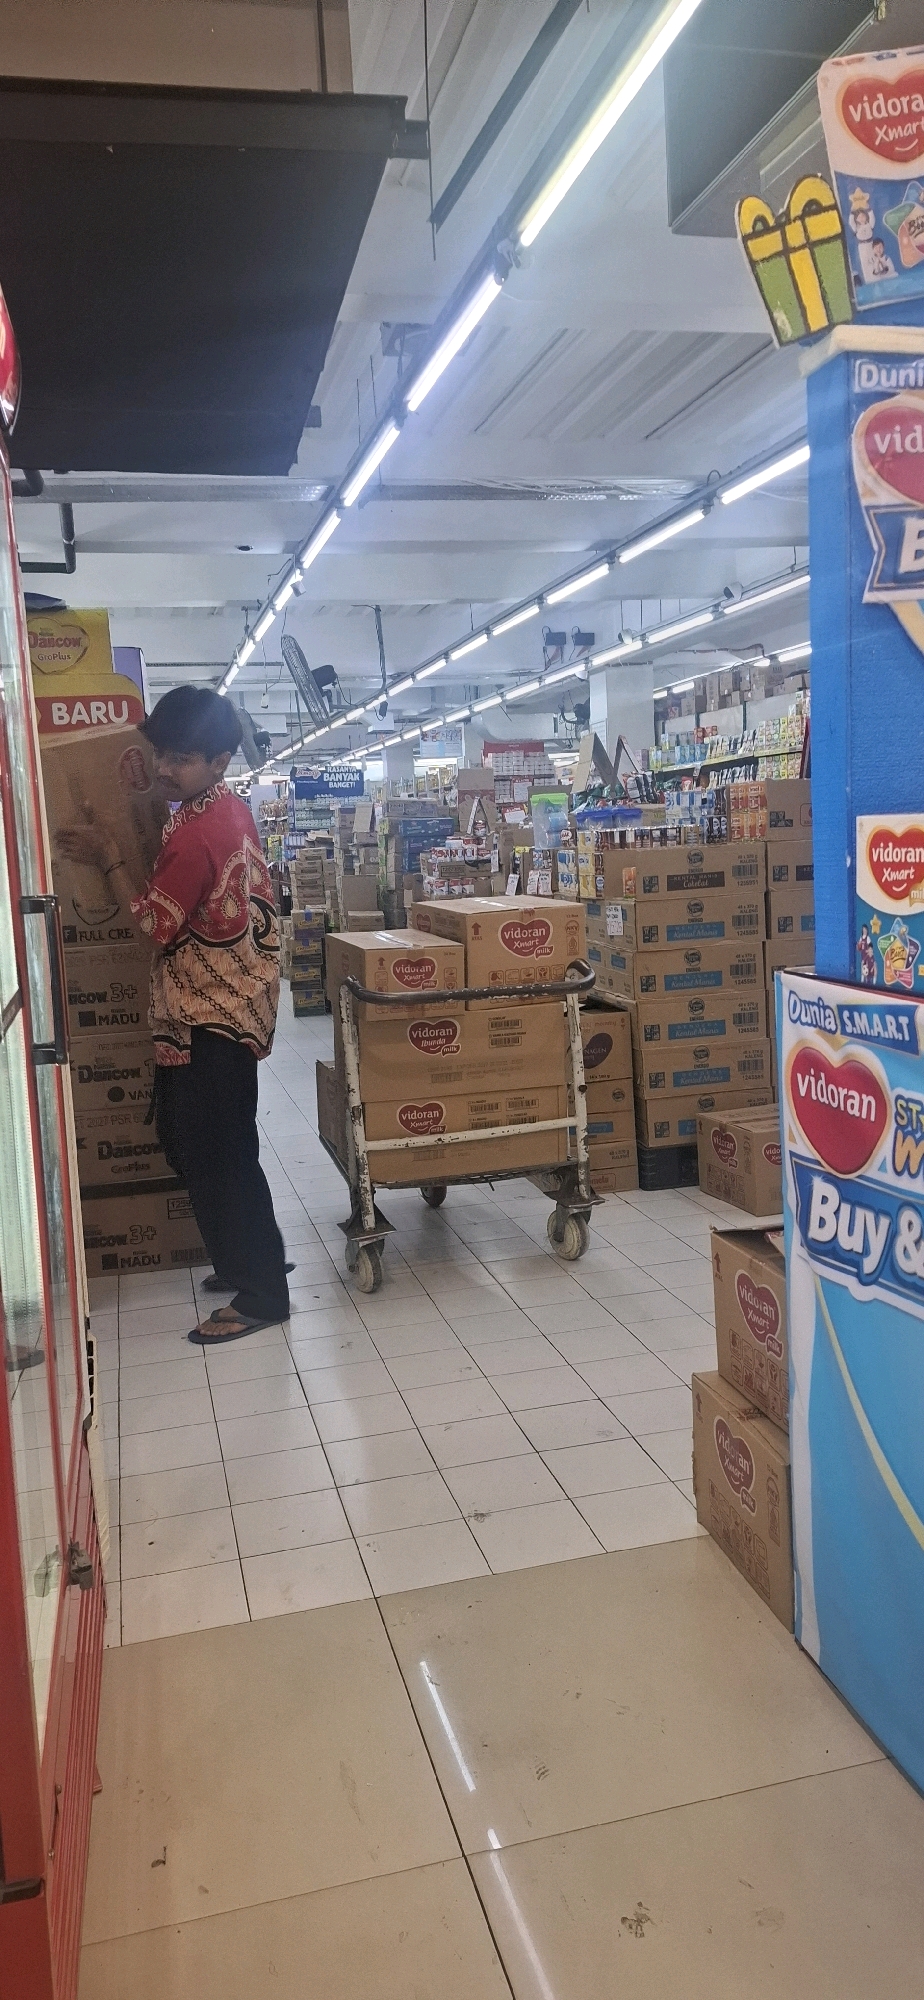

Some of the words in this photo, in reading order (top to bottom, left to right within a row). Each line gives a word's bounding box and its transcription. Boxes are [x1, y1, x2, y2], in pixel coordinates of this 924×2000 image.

[38, 652, 71, 660] GroPlus
[51, 700, 129, 726] BARU
[323, 773, 360, 782] BANYAK
[882, 867, 915, 883] Xmart
[79, 930, 104, 942] FULL
[504, 926, 546, 940] vidoran
[513, 938, 539, 949] Xmart
[395, 964, 432, 973] vidoran
[110, 983, 137, 1002] 3+
[789, 991, 837, 1031] Dunia
[99, 1013, 140, 1026] MADU
[411, 1028, 453, 1039] vidoran
[421, 1038, 446, 1047] Ibunda
[796, 1069, 876, 1122] vidoran
[401, 1110, 439, 1121] vidoran
[410, 1120, 433, 1129] Xmart
[713, 1135, 734, 1150] vidoran
[111, 1162, 151, 1174] GroPlus
[808, 1178, 891, 1276] Buy
[895, 1208, 924, 1276] &
[129, 1225, 157, 1245] 3+
[120, 1254, 161, 1268] MADU
[739, 1285, 775, 1321] vidoran
[747, 1307, 770, 1330] Xmart
[717, 1430, 750, 1474] vidoran
[725, 1455, 745, 1481] Xmart
